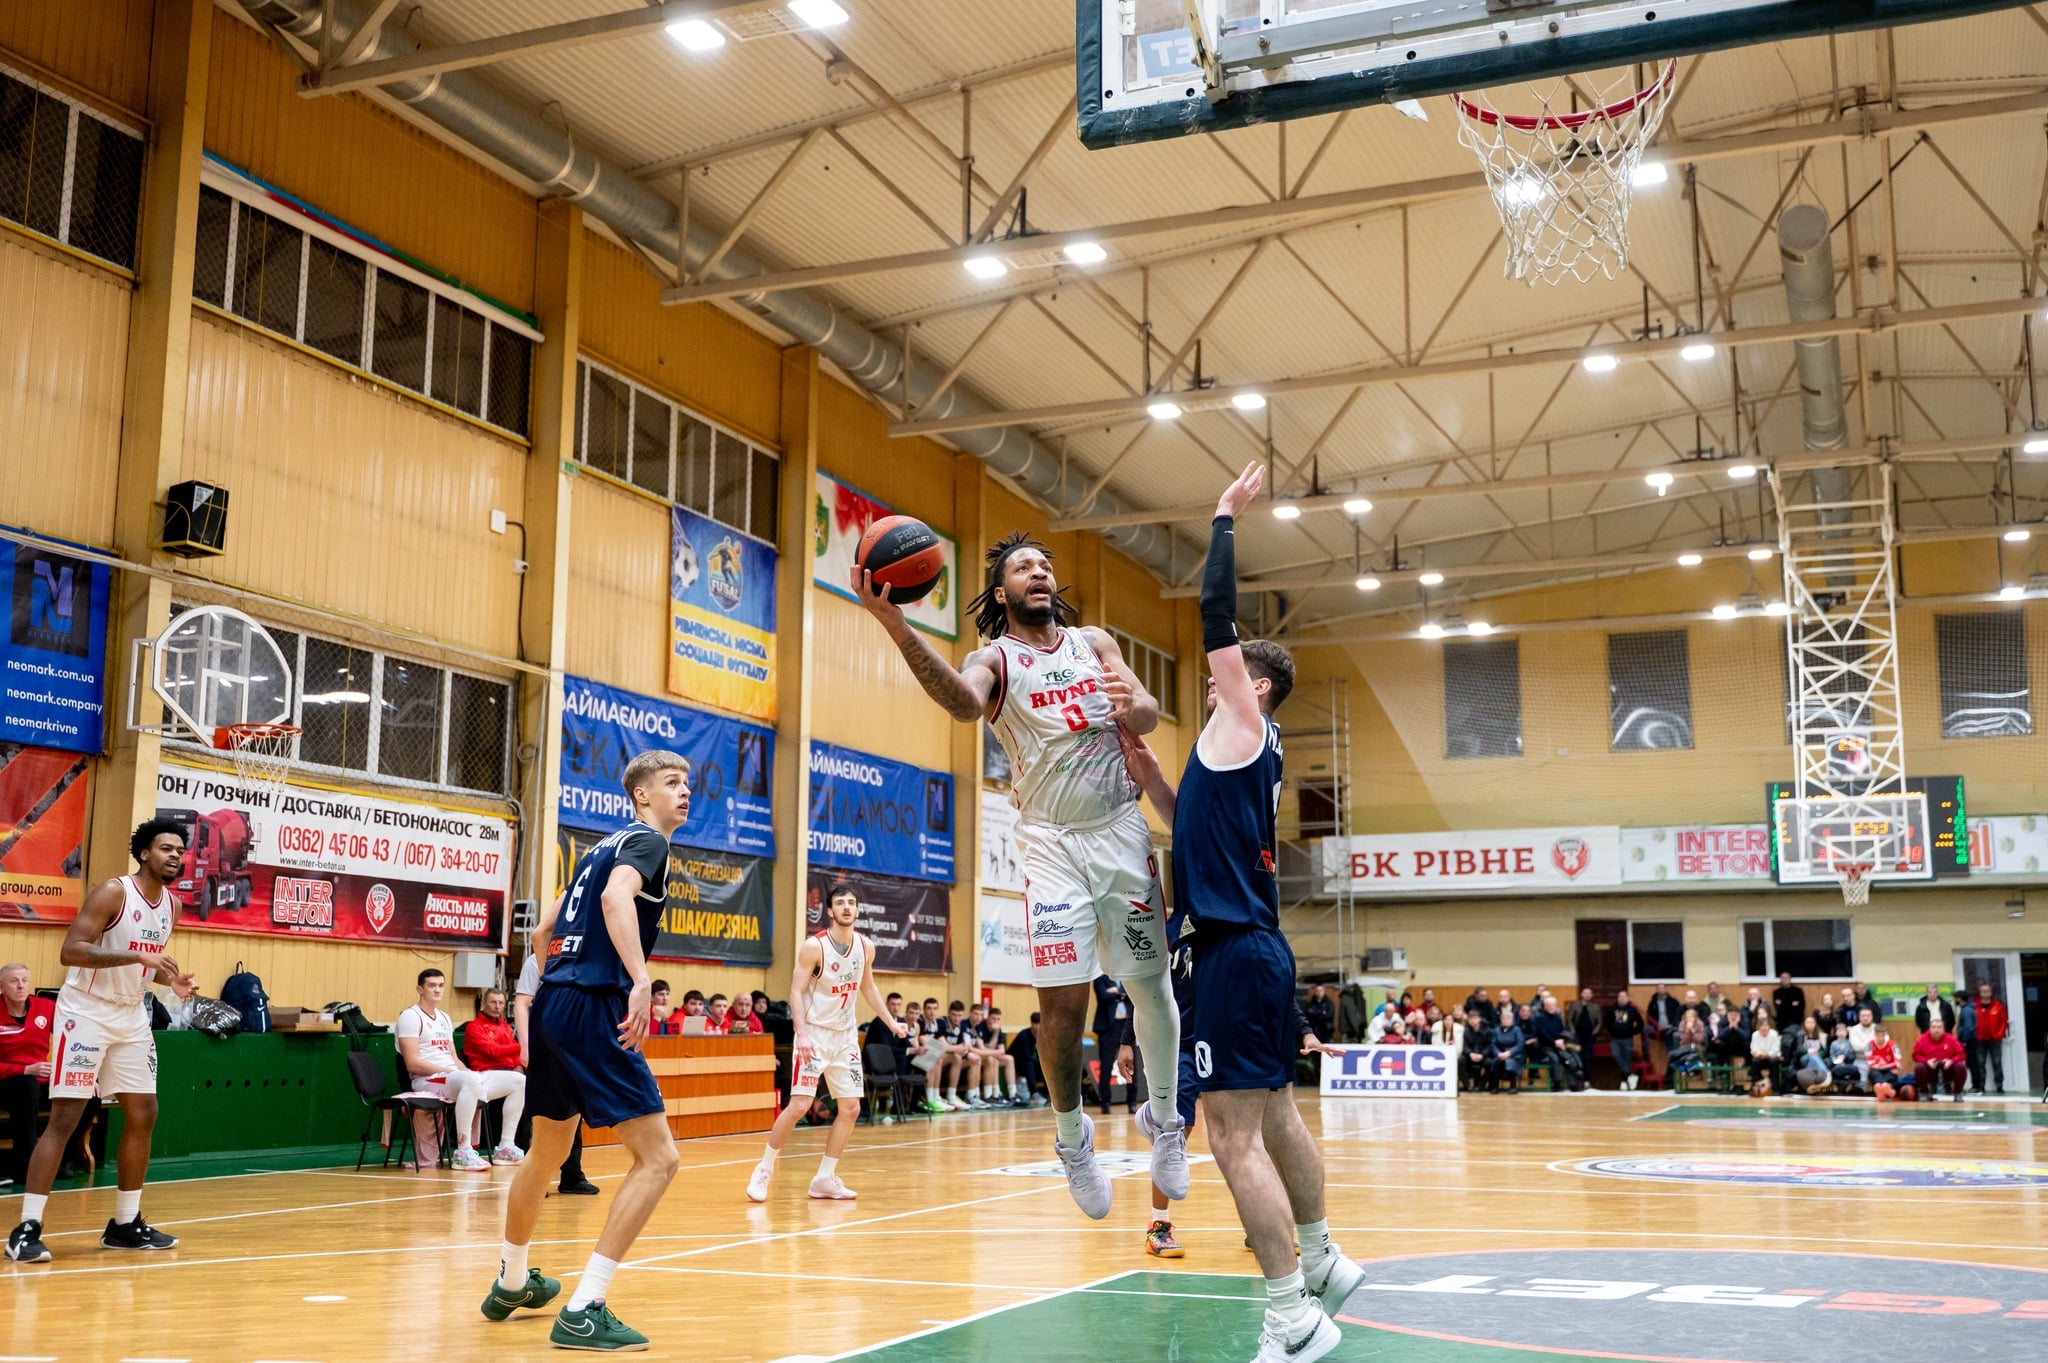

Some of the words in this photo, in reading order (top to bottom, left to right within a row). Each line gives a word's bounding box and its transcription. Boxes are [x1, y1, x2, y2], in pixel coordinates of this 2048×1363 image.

[895, 526, 919, 542] FBU
[7, 660, 94, 684] neomark.com.ua
[1042, 669, 1075, 682] TBG
[7, 688, 103, 715] neomark.company
[1029, 678, 1097, 709] RIVNE
[5, 715, 78, 735] neomarkrivne
[1061, 703, 1089, 732] 0
[203, 783, 270, 808] РОЗЧИН
[282, 798, 361, 823] ДОСТАВКА
[373, 809, 473, 838] БЕТОНОНАСОС
[278, 824, 324, 859] (0362)
[328, 832, 346, 856] 45
[349, 834, 368, 860] 06
[372, 837, 390, 862] 43
[404, 841, 436, 872] (067)
[440, 846, 499, 875] 364-20-07
[1676, 830, 1769, 853] INTER
[1351, 852, 1400, 879] БК
[1414, 847, 1535, 876] РІВНЕ
[1677, 853, 1769, 874] BETON
[1, 882, 62, 897] group.com
[276, 876, 333, 904] INTER
[565, 863, 593, 922] 6
[668, 881, 699, 904] ФОНД
[274, 901, 332, 925] BETON
[427, 896, 462, 915] ЯКІСТЬ
[463, 900, 487, 916] МАЄ
[1033, 902, 1072, 917] Dream
[426, 914, 459, 930] СВОЮ
[460, 917, 486, 933] ЦІНУ
[671, 908, 760, 941] ШАКИРЗЯНА
[1127, 914, 1155, 923] imtrex
[141, 929, 160, 939] TBG
[1034, 941, 1075, 957] INTER
[1035, 952, 1078, 967] BETON
[840, 993, 849, 1010] 7
[70, 1042, 100, 1052] Dream
[1333, 1050, 1446, 1076] ТАС
[65, 1071, 94, 1080] INTER
[65, 1079, 94, 1087] BETON
[1336, 1080, 1441, 1090] ТАСКОМБАНК
[1356, 1274, 2048, 1320] G.BET
